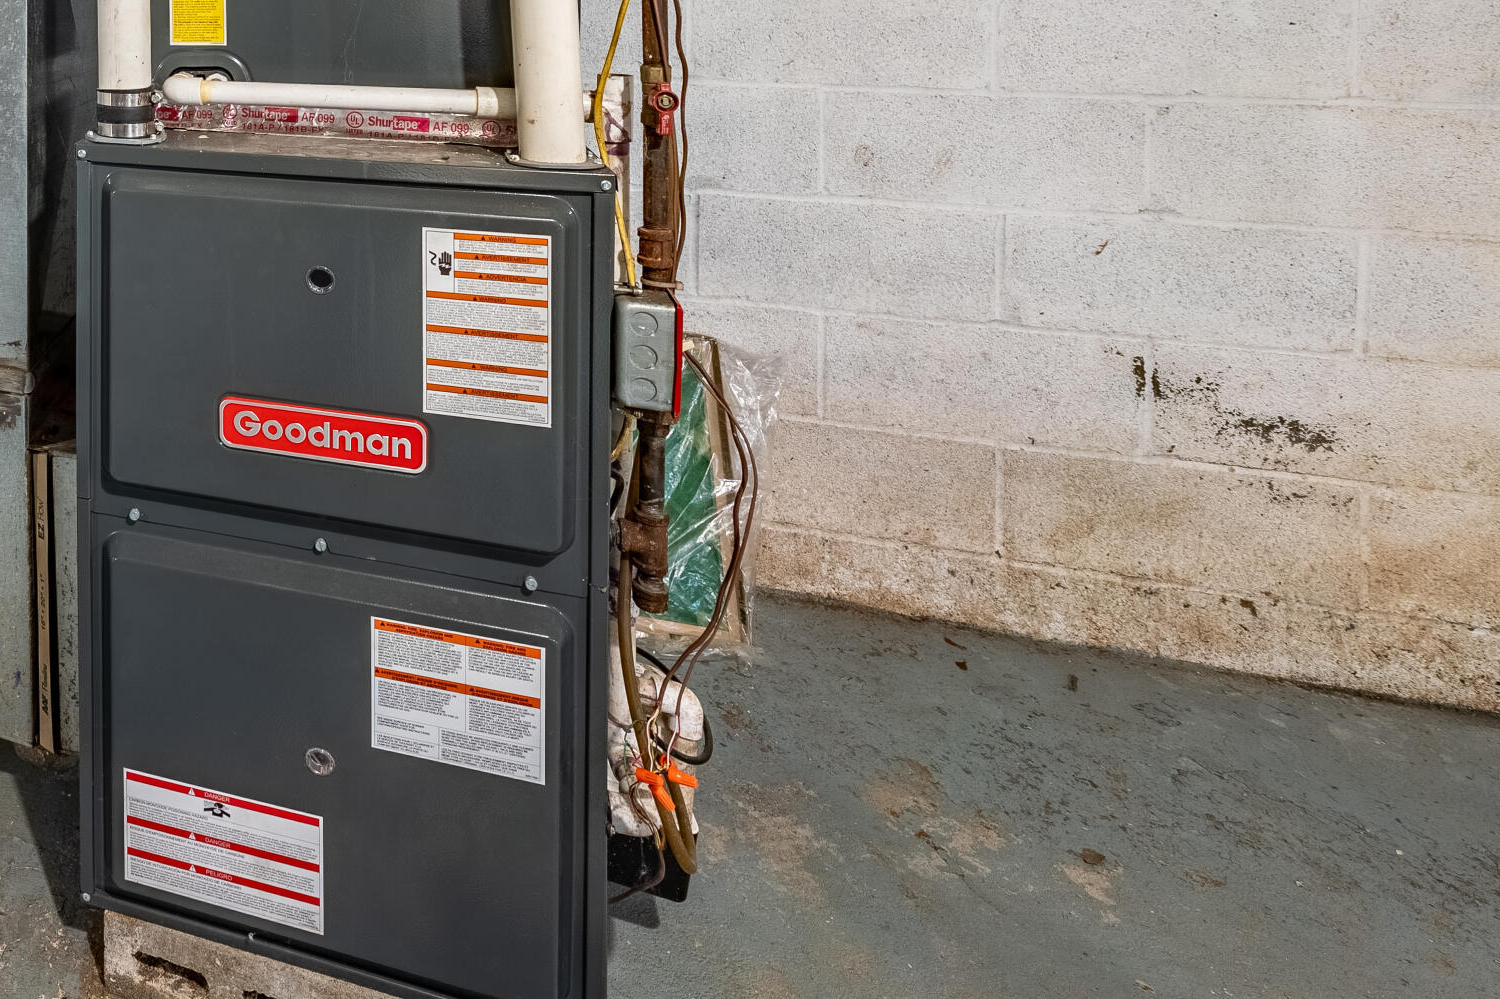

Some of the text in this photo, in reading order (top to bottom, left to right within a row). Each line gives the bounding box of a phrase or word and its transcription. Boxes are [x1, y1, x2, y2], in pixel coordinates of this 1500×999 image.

[241, 107, 289, 122] Shurtape
[368, 115, 419, 130] Shurtape
[433, 122, 448, 132] AF
[451, 123, 470, 134] 099
[488, 236, 517, 244] WARNING
[479, 296, 507, 304] WARNING
[480, 365, 508, 373] WARNING
[233, 410, 412, 460] Goodman
[37, 522, 45, 541] EZ
[204, 791, 230, 803] DANGER
[204, 837, 231, 849] DANGER
[205, 869, 233, 881] PELIGRO
